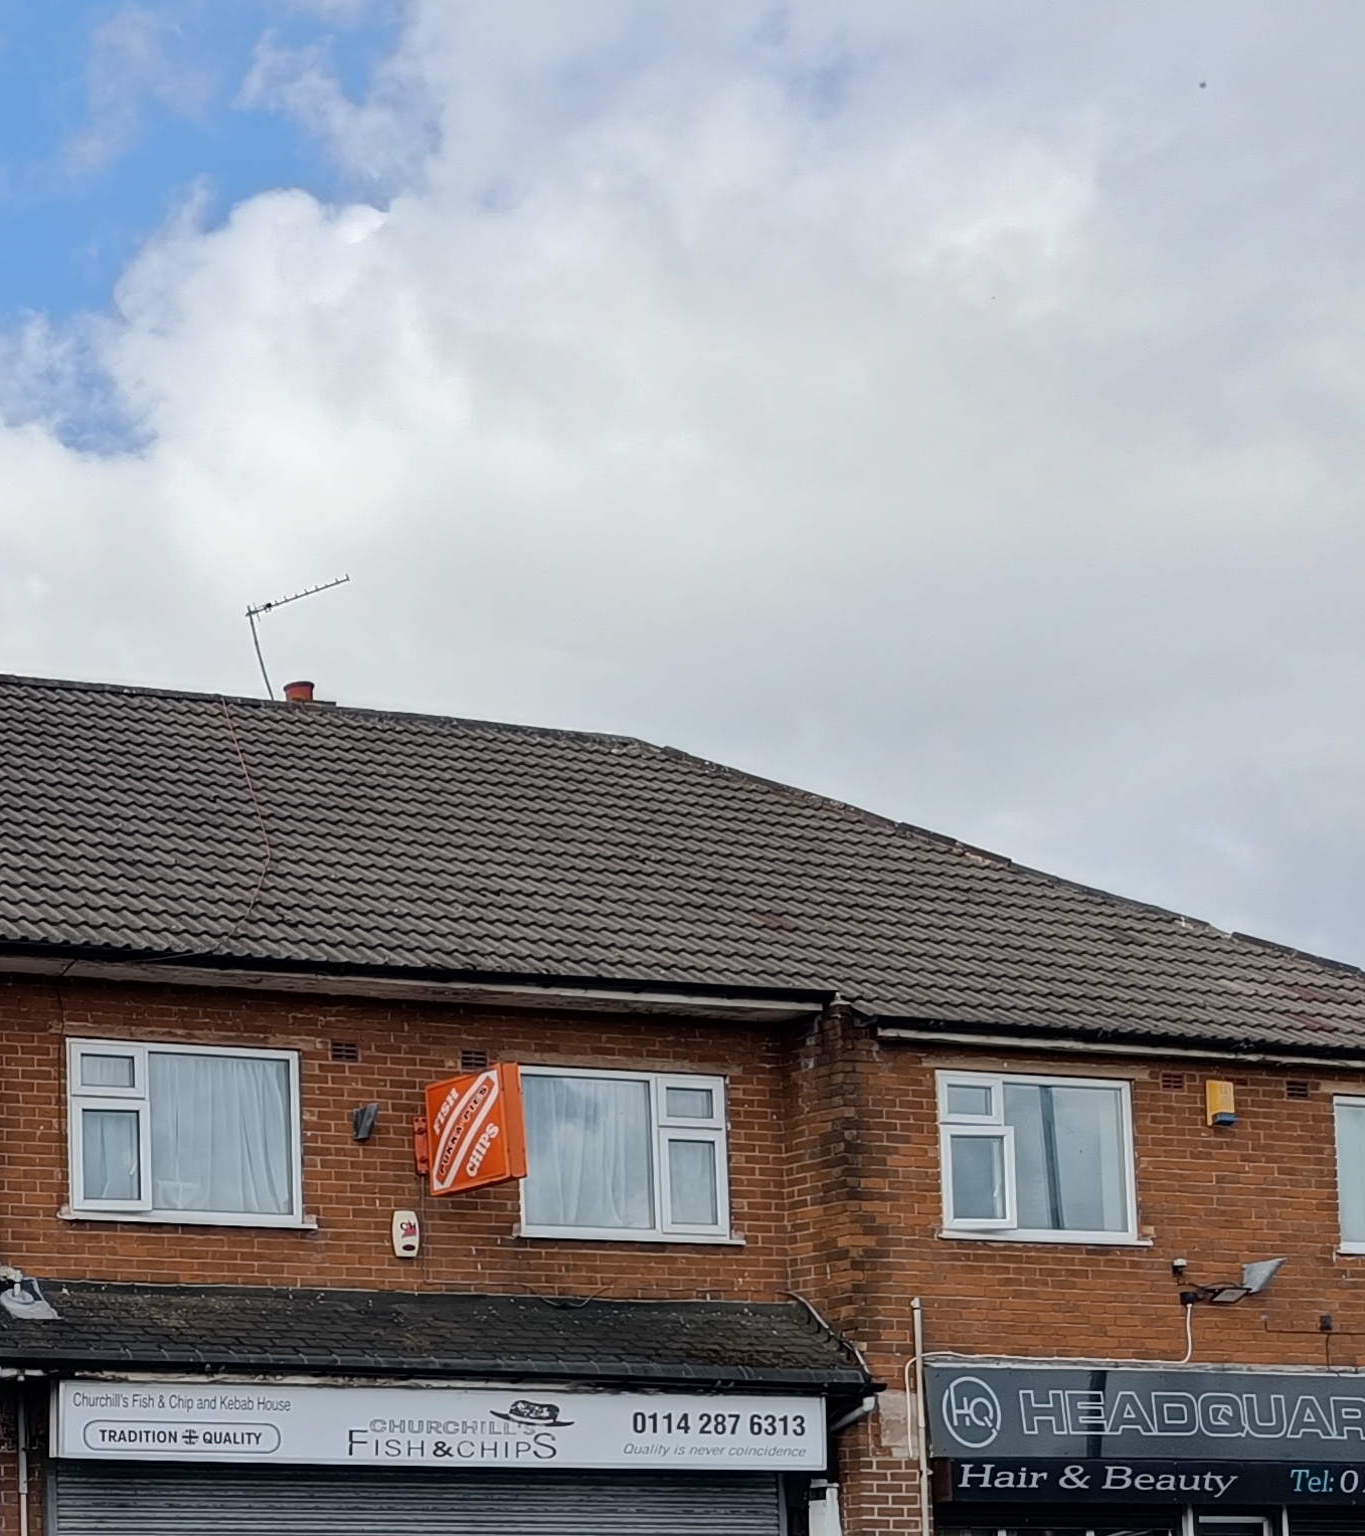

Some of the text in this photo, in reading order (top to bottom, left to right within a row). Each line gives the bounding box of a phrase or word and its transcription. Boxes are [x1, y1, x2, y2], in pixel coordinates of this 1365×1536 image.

[433, 1087, 460, 1136] FISH
[466, 1123, 499, 1177] CHIPS
[72, 1392, 291, 1412] Churchill's Fish & Chip and Kebab House
[1019, 1389, 1365, 1440] HEADQUAR
[99, 1429, 262, 1445] TRADITION QUALITY
[632, 1412, 806, 1436] 0114 287 6313
[623, 1443, 806, 1457] Quality is never coincidence
[958, 1464, 1365, 1498] Hair & Beauty Tel: 0
